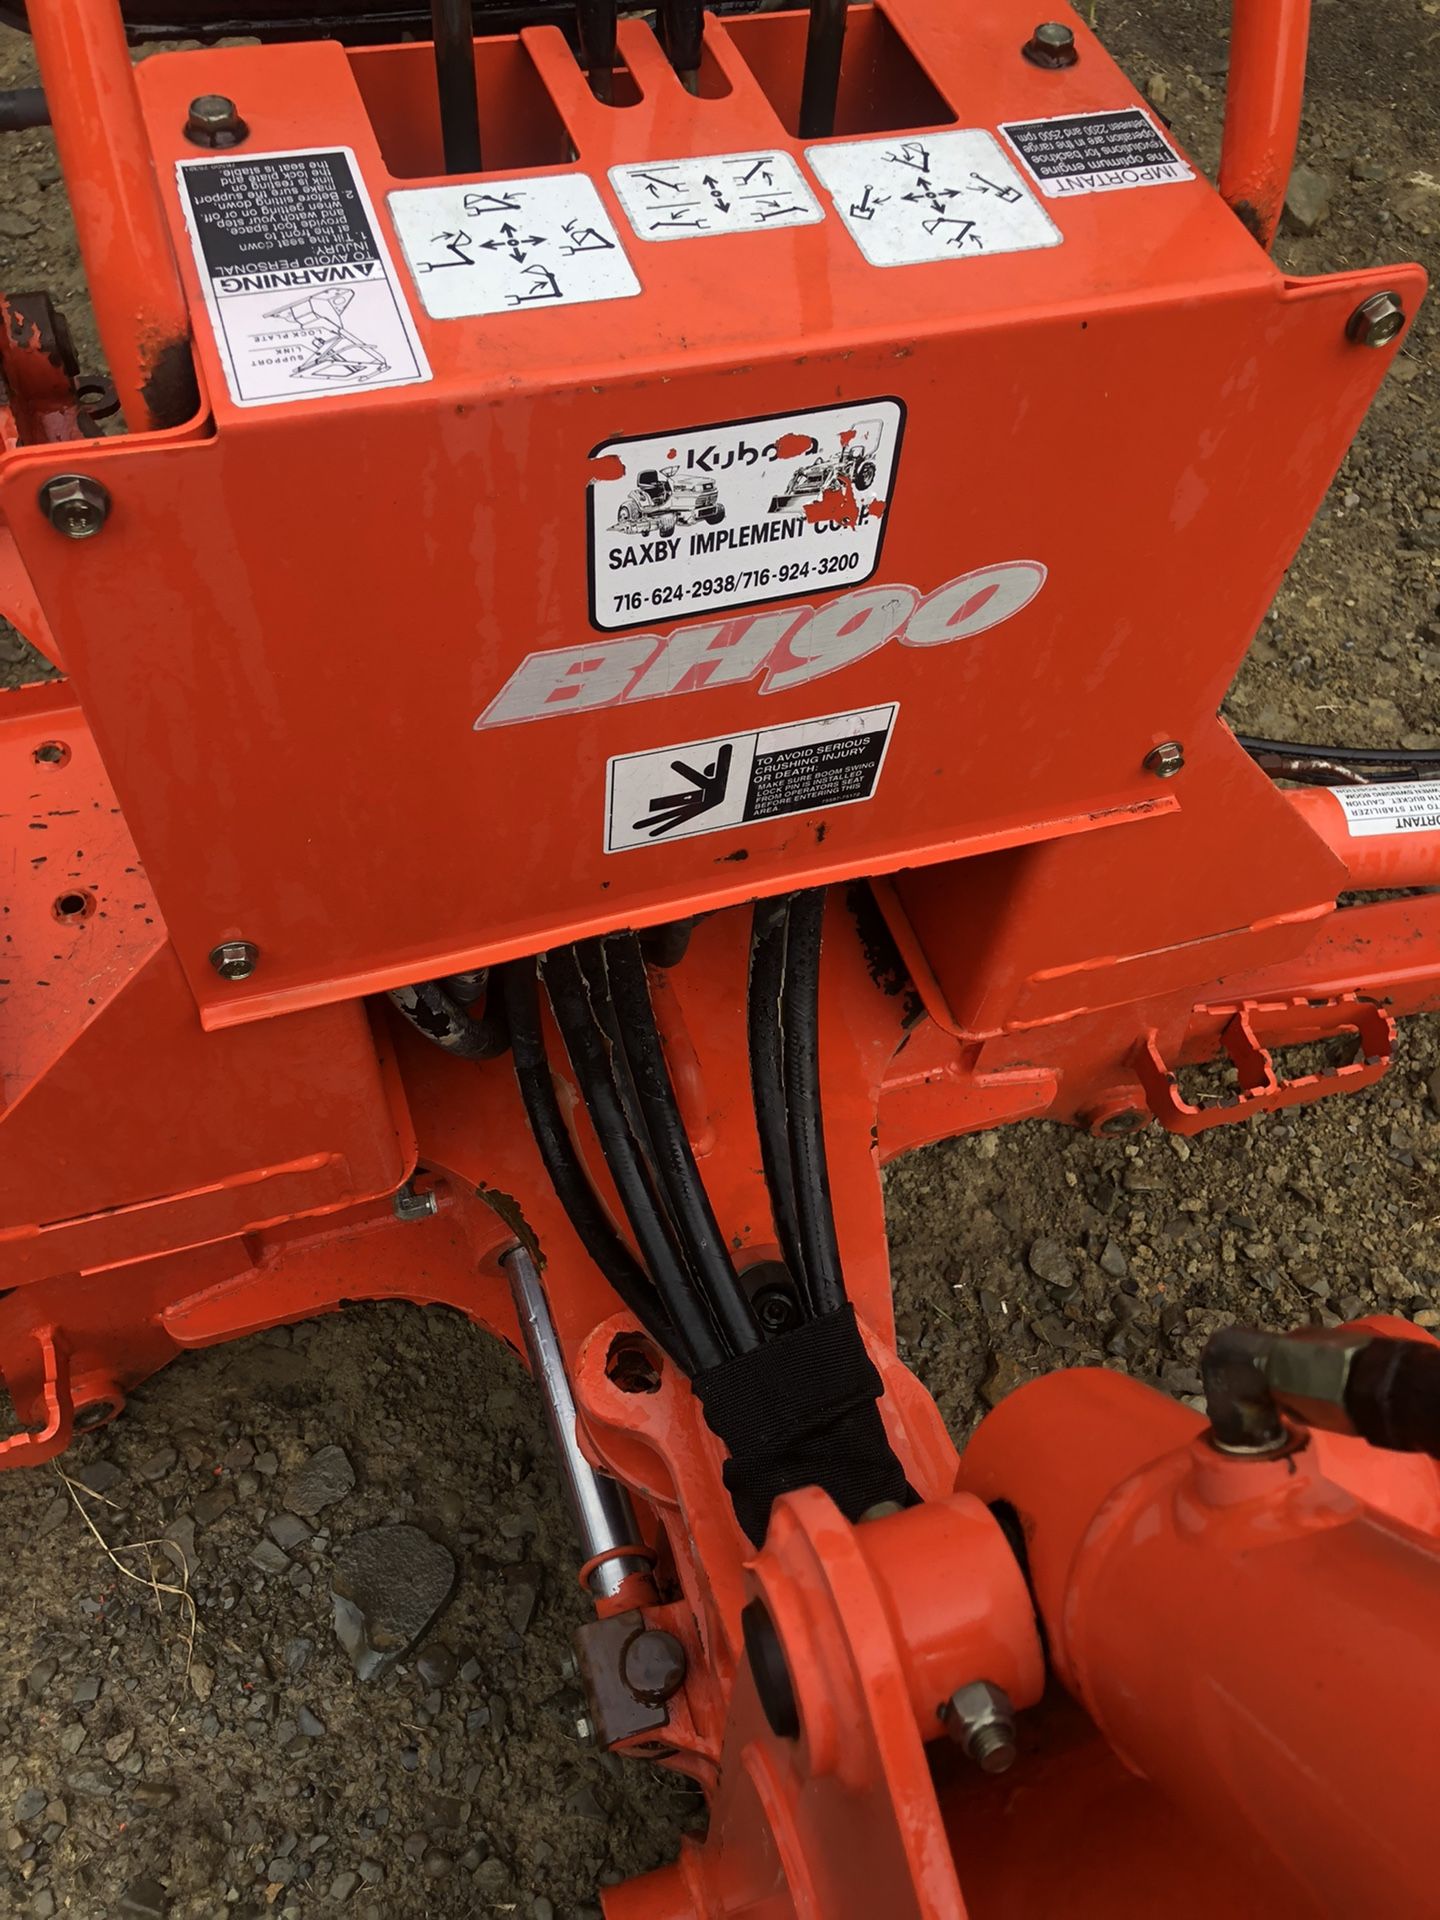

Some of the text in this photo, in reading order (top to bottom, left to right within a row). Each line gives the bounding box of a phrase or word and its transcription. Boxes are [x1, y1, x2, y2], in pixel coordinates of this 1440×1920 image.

[1014, 119, 1149, 142] between 2200 and 2500 rpm.
[1023, 130, 1155, 153] operation are in the range
[1031, 141, 1163, 163] revolutions for backhoe
[265, 166, 274, 174] is
[279, 163, 305, 172] seat
[309, 161, 328, 169] the
[1040, 152, 1175, 175] The optimum engine
[220, 167, 260, 177] stable.
[220, 169, 330, 187] the lock plate and
[1056, 165, 1177, 192] IMPORTANT
[231, 184, 247, 192] on
[251, 180, 293, 191] resting
[312, 176, 335, 188] link
[195, 185, 336, 205] make sure the support
[256, 196, 293, 206] sitting
[298, 192, 339, 202] Before
[342, 190, 354, 199] 2.
[201, 201, 342, 223] when getting on or off.
[217, 208, 344, 228] and watch your step
[272, 222, 296, 231] foot
[301, 215, 347, 228] provide
[280, 231, 310, 239] front
[338, 225, 349, 233] at
[277, 238, 305, 248] seat
[309, 236, 329, 244] the
[333, 233, 354, 243] Tilt
[239, 241, 274, 252] down
[311, 242, 368, 255] INJURY:
[215, 252, 374, 275] TO AVOID PERSONAL
[220, 266, 355, 293] WARNING
[254, 329, 322, 342] LOCK PLATE
[252, 355, 304, 367] SUPPORT
[687, 436, 819, 472] Kuboa
[608, 510, 870, 570] SAXBY IMPLEMENT COP.
[613, 552, 859, 613] 716-624-2938/716-924-3200
[473, 559, 1048, 731] BH90
[757, 737, 870, 765] TO AVOID SERIOUS
[755, 746, 866, 775] CRUSHING INJURY
[754, 765, 818, 783] OR DEATH:
[758, 761, 875, 790] MAKE SURE BOOM SWING
[756, 776, 864, 803] FROM OPERATORS SEAT
[757, 787, 782, 796] LOCK
[785, 783, 800, 791] PIN
[813, 771, 862, 785] INSTALLED
[755, 800, 791, 809] BEFORE
[794, 788, 839, 801] ENTERING
[842, 783, 860, 791] THIS
[1346, 799, 1385, 807] CAUTION
[753, 806, 778, 815] AREA
[1351, 806, 1405, 816] STABILIZER
